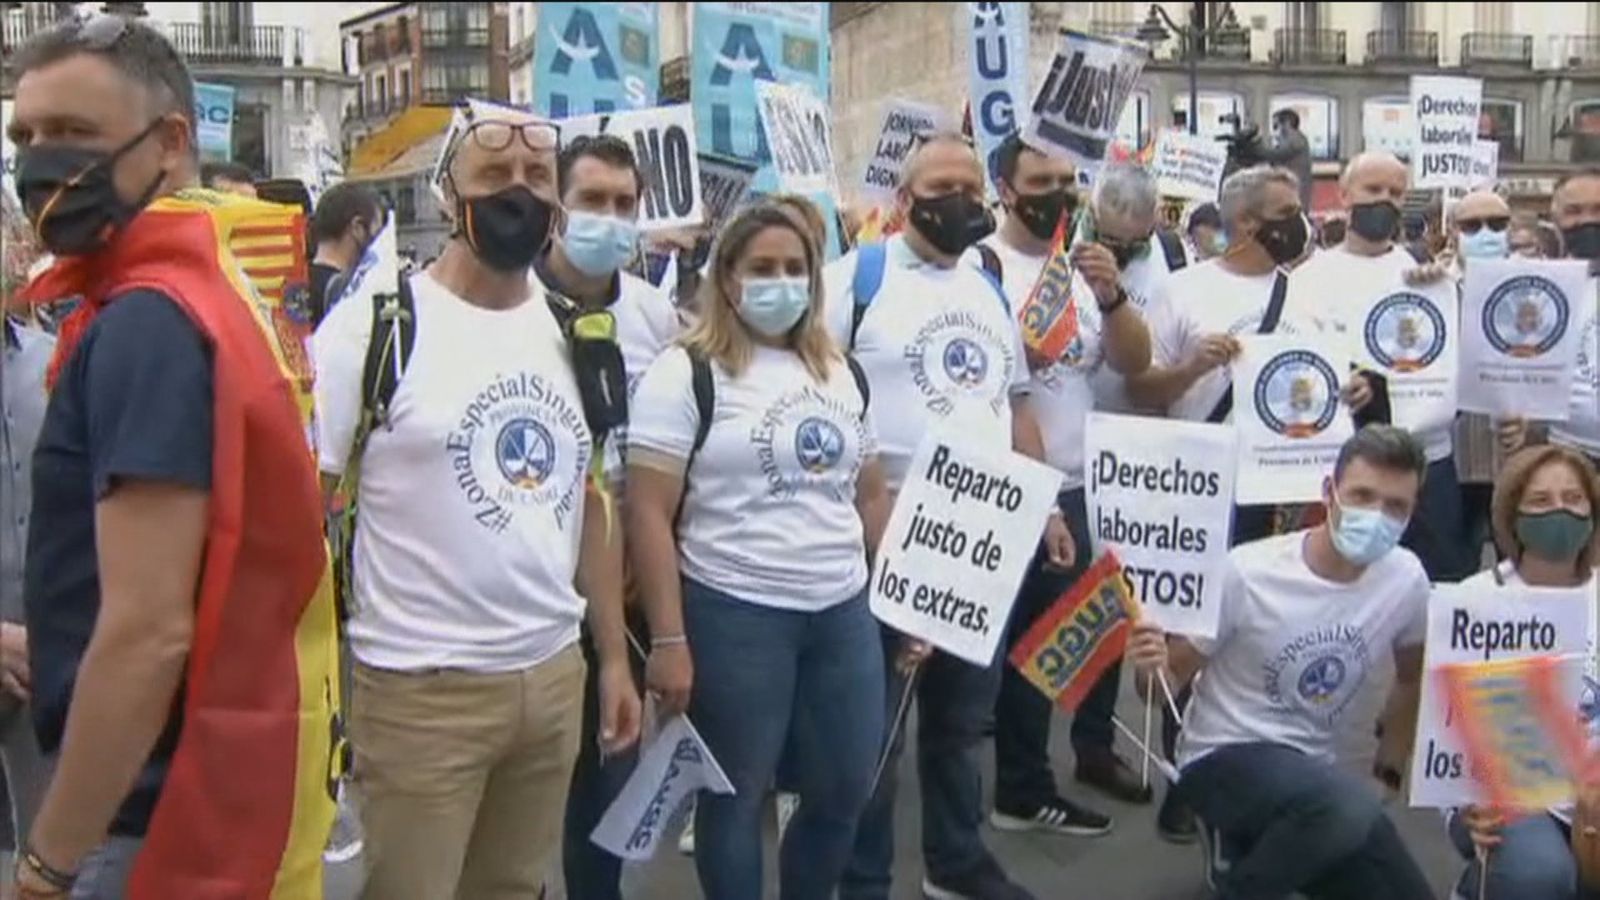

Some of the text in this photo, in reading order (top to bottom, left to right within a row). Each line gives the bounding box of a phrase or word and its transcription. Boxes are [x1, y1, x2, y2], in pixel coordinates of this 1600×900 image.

[926, 444, 1022, 512] Reparto
[1092, 450, 1219, 497] ¡Derechos
[902, 504, 1001, 571] justo de
[1097, 506, 1207, 553] laborales
[877, 559, 989, 635] los extras.
[1123, 565, 1204, 609] STOS!
[1451, 608, 1556, 661] Reparto
[1425, 740, 1462, 779] los
